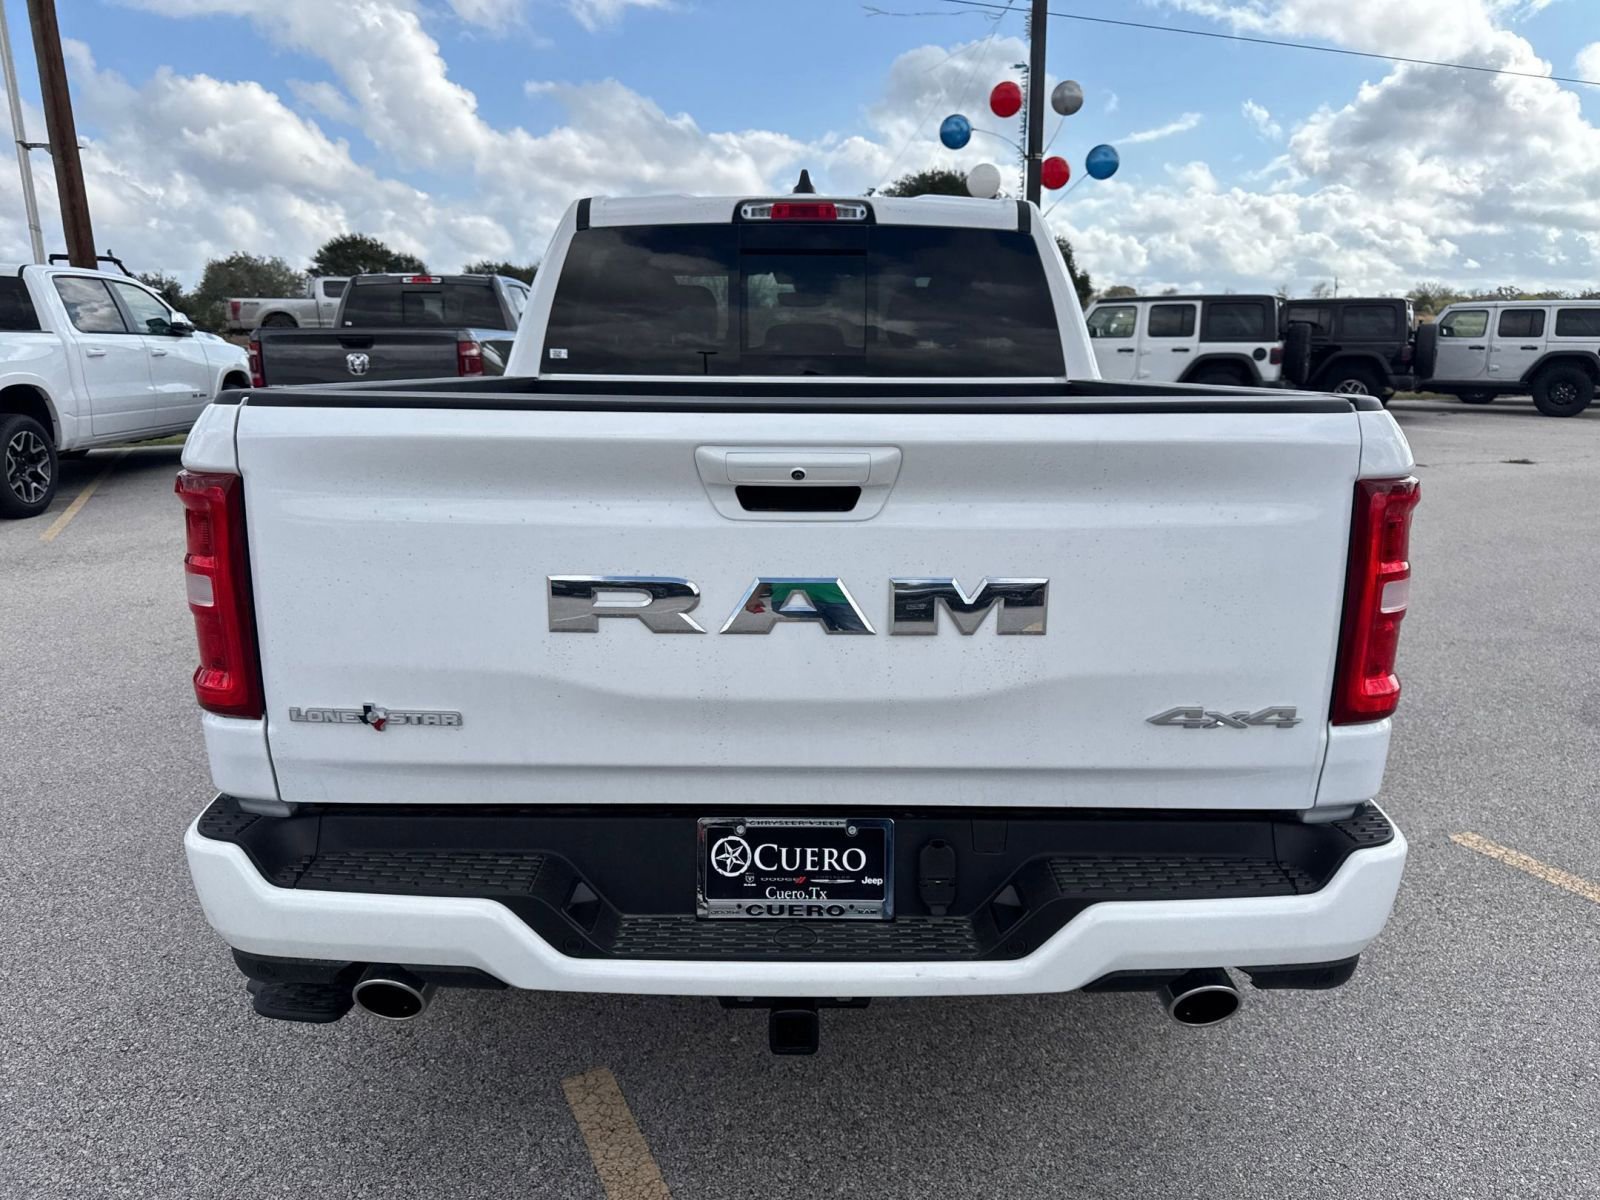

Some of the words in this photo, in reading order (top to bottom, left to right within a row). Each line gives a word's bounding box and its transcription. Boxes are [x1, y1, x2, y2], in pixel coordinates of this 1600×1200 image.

[546, 575, 1050, 636] RAM
[289, 706, 360, 724] LONE
[386, 710, 463, 727] STAR
[861, 875, 884, 886] Jeep
[745, 904, 846, 916] CUERO
